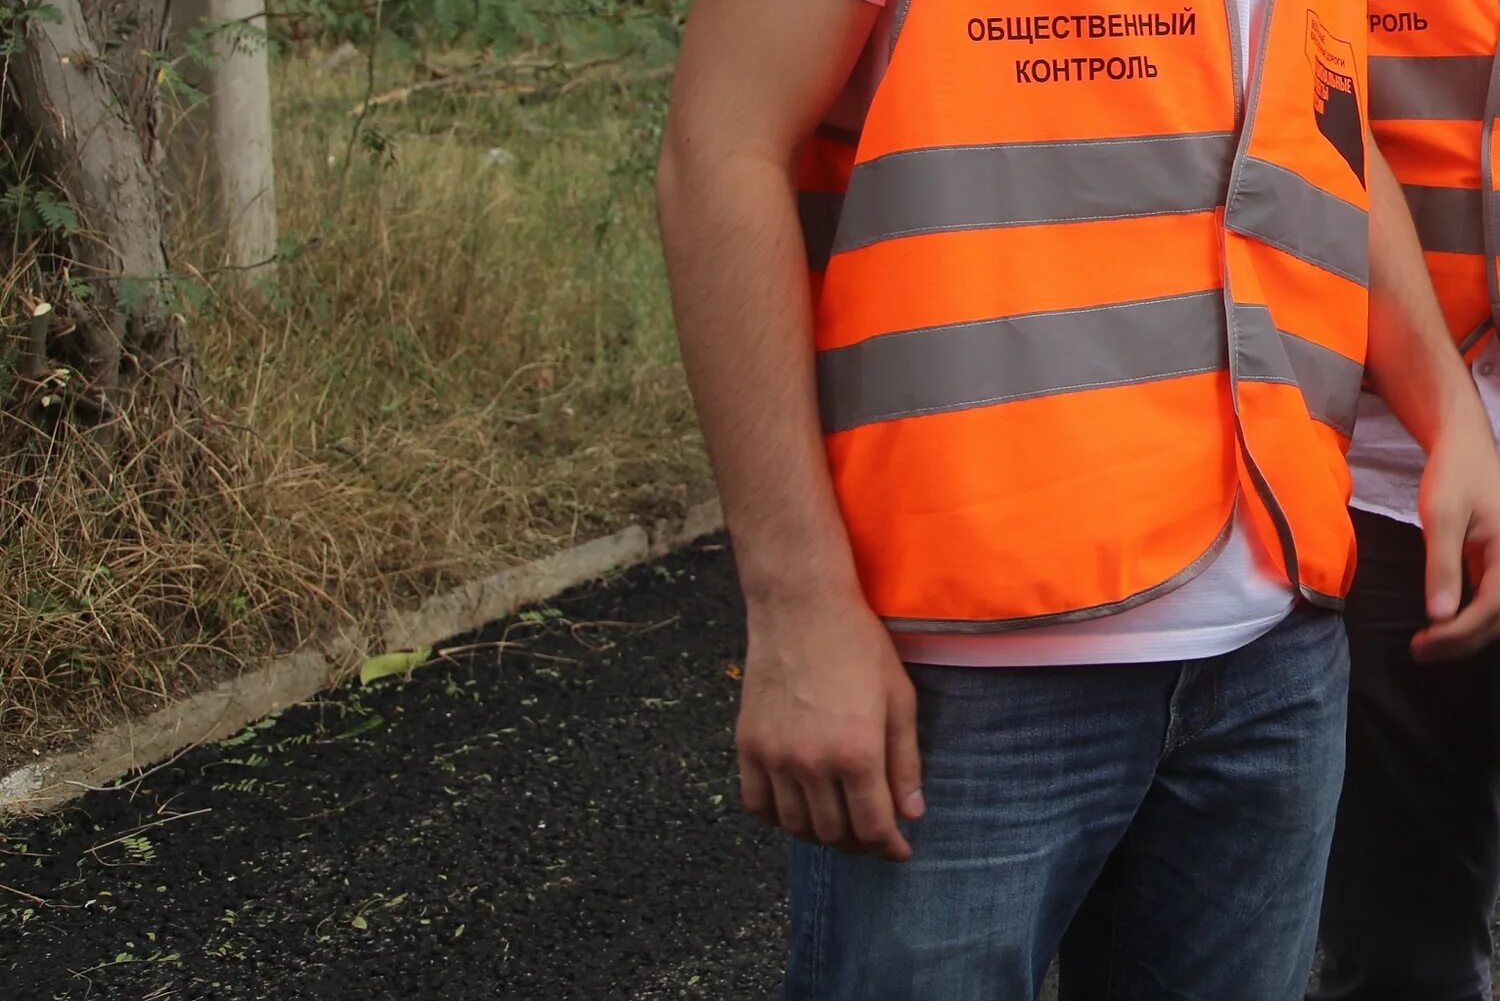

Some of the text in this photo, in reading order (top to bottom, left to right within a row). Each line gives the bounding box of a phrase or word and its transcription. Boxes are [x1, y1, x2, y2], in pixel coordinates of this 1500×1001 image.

[966, 6, 1196, 44] ОБЩЕСТВЕННЫЙ
[1367, 12, 1428, 32] РОЛЬ
[1016, 56, 1158, 83] КОНТРОЛЬ
